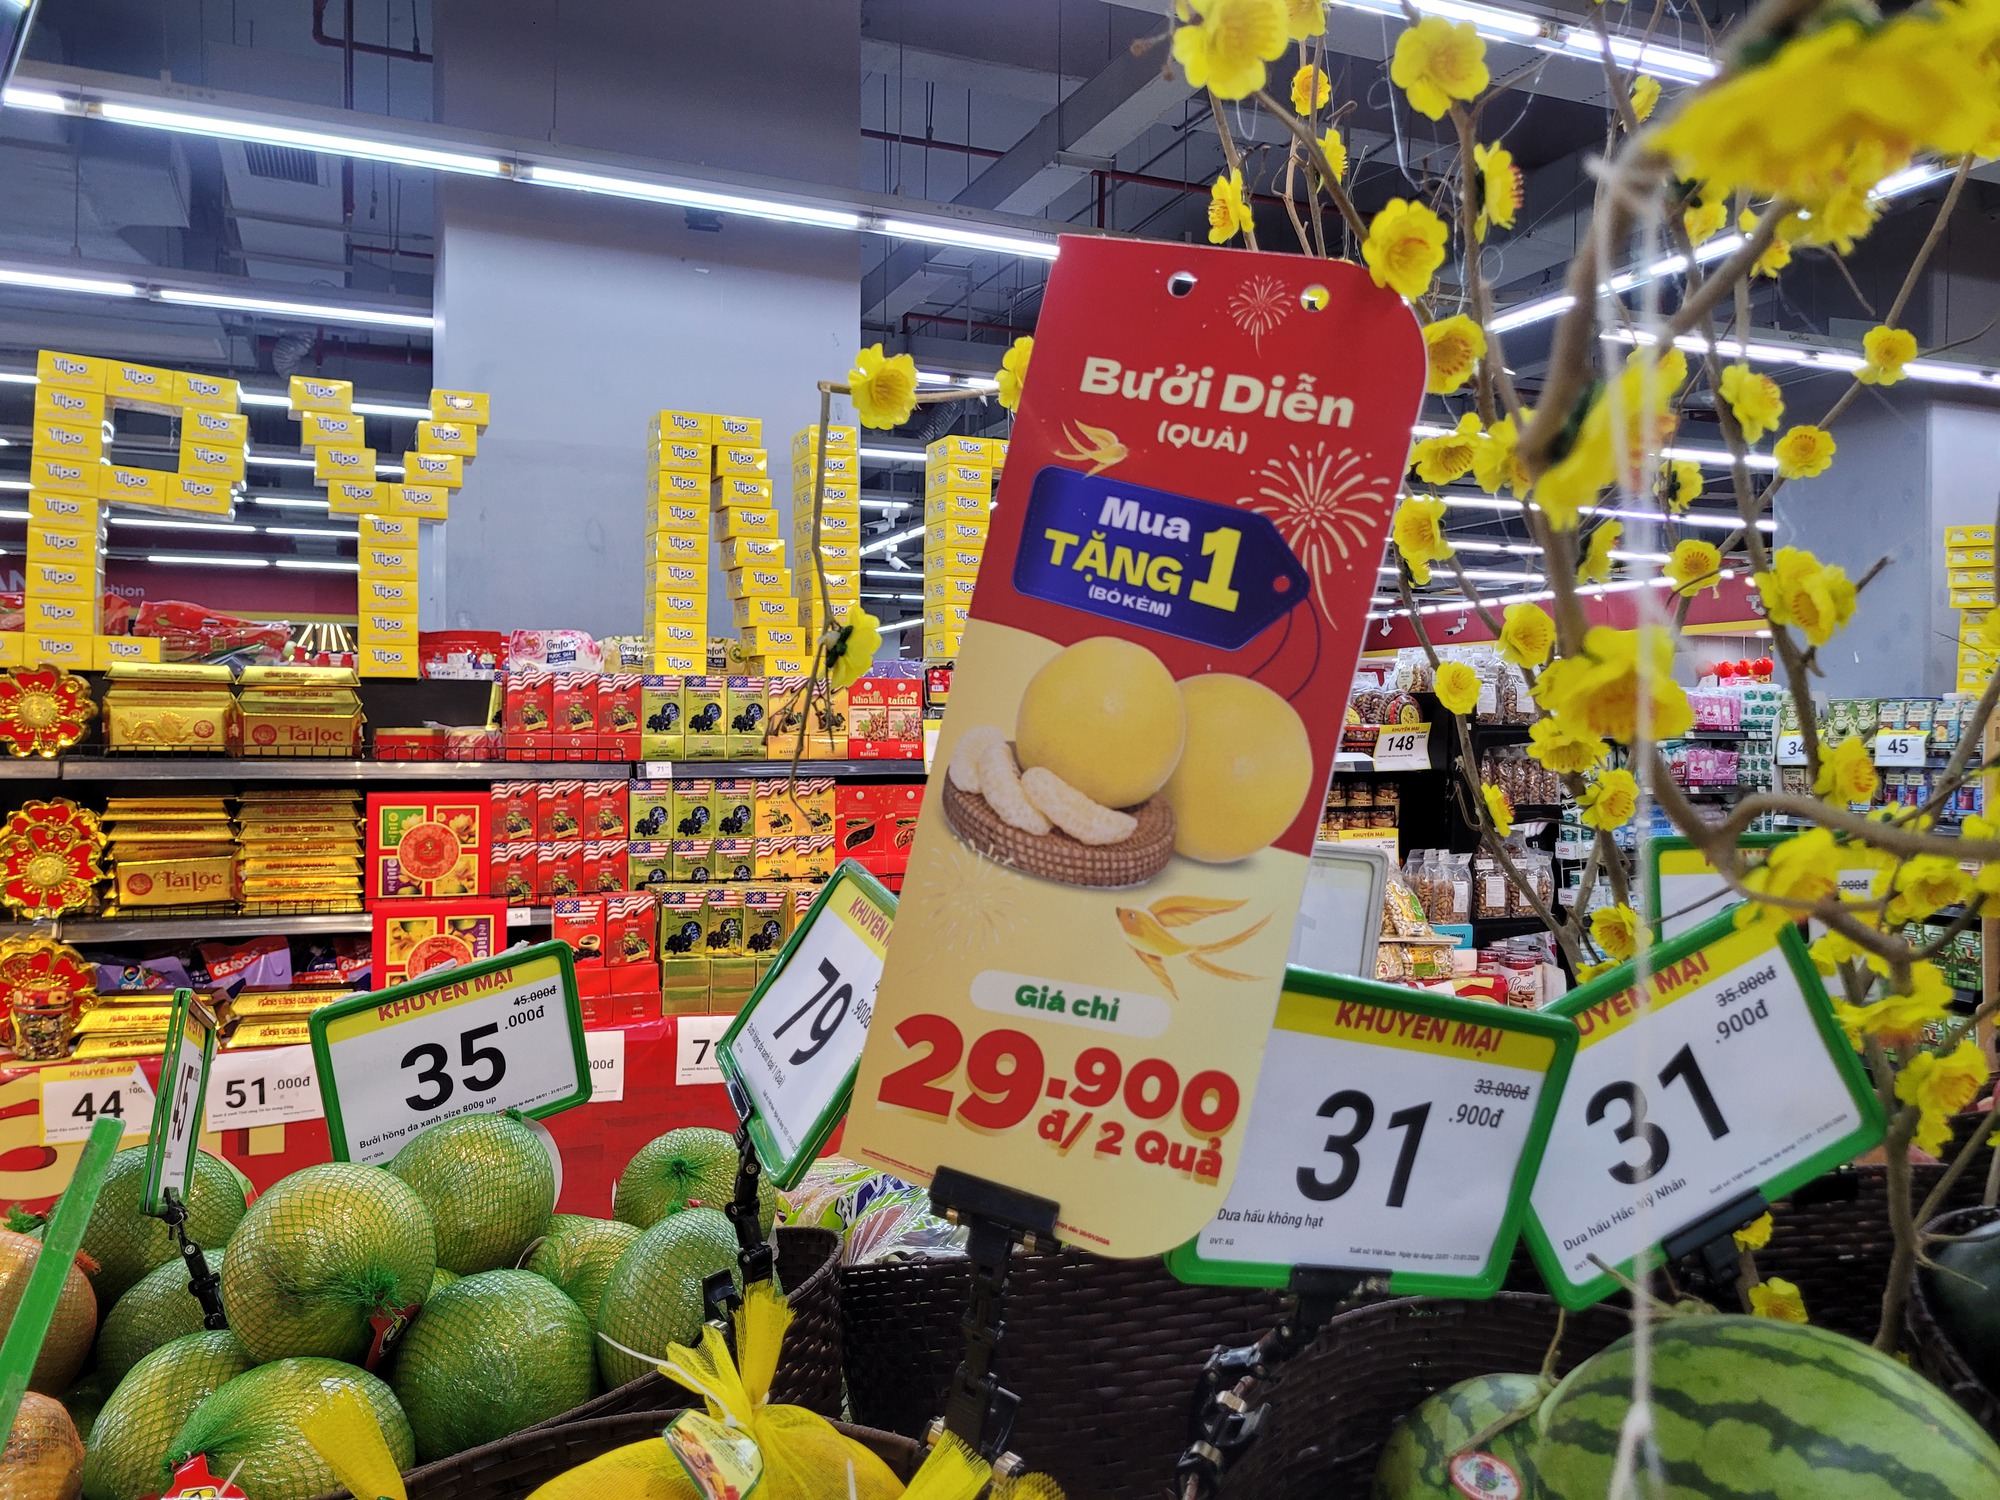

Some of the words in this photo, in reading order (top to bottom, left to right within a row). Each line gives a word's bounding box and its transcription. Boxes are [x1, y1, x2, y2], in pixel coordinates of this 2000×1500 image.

[53, 357, 87, 375] Tipo
[122, 367, 156, 385] Tipo
[187, 378, 221, 395] Tipo
[305, 382, 336, 398] Tipo
[1080, 356, 1214, 409] Bưởi
[1219, 372, 1355, 429] Diễn
[51, 392, 85, 409] Tipo
[197, 413, 230, 430] Tipo
[317, 417, 348, 432] Tipo
[672, 414, 698, 429] Tipo
[722, 420, 748, 434] Tipo
[49, 428, 83, 444] Tipo
[431, 426, 461, 441] Tipo
[827, 430, 844, 442] ipo
[1157, 420, 1248, 455] (QUẢ)
[671, 445, 698, 459] Tipo
[958, 440, 982, 453] Tipo
[195, 447, 227, 464] Tipo
[328, 451, 360, 466] Tipo
[729, 451, 754, 465] Tipo
[46, 463, 81, 480] Tipo
[417, 457, 447, 472] Tipo
[114, 470, 148, 487] Tipo
[957, 468, 980, 481] Tipo
[181, 479, 214, 496] Tipo
[670, 476, 696, 490] Tipo
[734, 481, 759, 495] Tipo
[342, 484, 373, 499] Tipo
[402, 489, 431, 504] Tipo
[823, 488, 847, 500] Tipo
[44, 497, 79, 515] Tipo
[956, 496, 979, 509] Tipo
[669, 506, 695, 520] Tipo
[741, 511, 765, 525] Tipo
[1098, 496, 1191, 543] Mua
[372, 519, 402, 534] Tipo
[823, 516, 847, 529] Tipo
[955, 524, 978, 537] Tipo
[43, 533, 78, 550] Tipo
[669, 536, 694, 550] Tipo
[747, 541, 772, 555] Tipo
[372, 552, 402, 567] Tipo
[956, 552, 979, 565] Tipo
[41, 567, 76, 584] Tipo
[668, 566, 694, 580] Tipo
[1044, 529, 1184, 597] TẶNG
[1189, 526, 1242, 613] 1
[753, 572, 778, 585] Tipo
[372, 584, 402, 599] Tipo
[40, 602, 75, 620] Tipo
[667, 596, 693, 610] Tipo
[760, 601, 784, 614] Tipo
[830, 604, 847, 616] ipo
[372, 617, 402, 631] Tipo
[667, 626, 693, 640] Tipo
[768, 630, 792, 643] Tipo
[38, 638, 74, 655] Tipo
[108, 640, 142, 657] Tipo
[372, 649, 402, 664] Tipo
[667, 657, 693, 670] Tipo
[775, 660, 800, 673] Tipo
[1388, 735, 1415, 752] 148
[1888, 738, 1909, 754] 45
[475, 969, 514, 994] MẠI
[1653, 951, 1710, 997] MẠI
[1716, 965, 1777, 1008] 35.000đ
[513, 985, 558, 1007] 45.000đ
[1014, 983, 1067, 1014] Giá
[1071, 993, 1121, 1023] chỉ
[772, 957, 853, 1065] 79
[1453, 1026, 1503, 1056] MẠI
[400, 1021, 507, 1112] 35
[504, 1004, 545, 1030] .000đ
[69, 1066, 114, 1078] KHUYẾN
[877, 1013, 1241, 1135] 29.900
[225, 1077, 266, 1108] 51
[273, 1076, 310, 1091] .000đ
[1474, 1079, 1531, 1101] 33.000đ
[1585, 1043, 1730, 1185] 31
[1716, 999, 1770, 1045] .900đ
[72, 1090, 124, 1122] 44
[359, 1131, 382, 1149] Bưởi
[382, 1127, 406, 1141] hồng
[407, 1121, 419, 1133] da
[420, 1115, 442, 1128] xanh
[443, 1109, 461, 1120] size
[463, 1100, 485, 1114] 800g
[485, 1095, 498, 1109] up
[1036, 1108, 1094, 1152] đ/
[1095, 1121, 1126, 1156] 2
[1134, 1128, 1224, 1180] Quả
[1296, 1089, 1433, 1208] 31
[1448, 1104, 1504, 1129] .900đ
[1217, 1207, 1241, 1223] Dưa
[1243, 1208, 1265, 1225] hấu
[1267, 1211, 1302, 1229] không
[1305, 1213, 1324, 1229] hạt
[1563, 1235, 1588, 1251] Dưa
[1589, 1219, 1611, 1238] hấu
[1611, 1204, 1636, 1225] Hắc
[1655, 1177, 1687, 1199] Nhân
